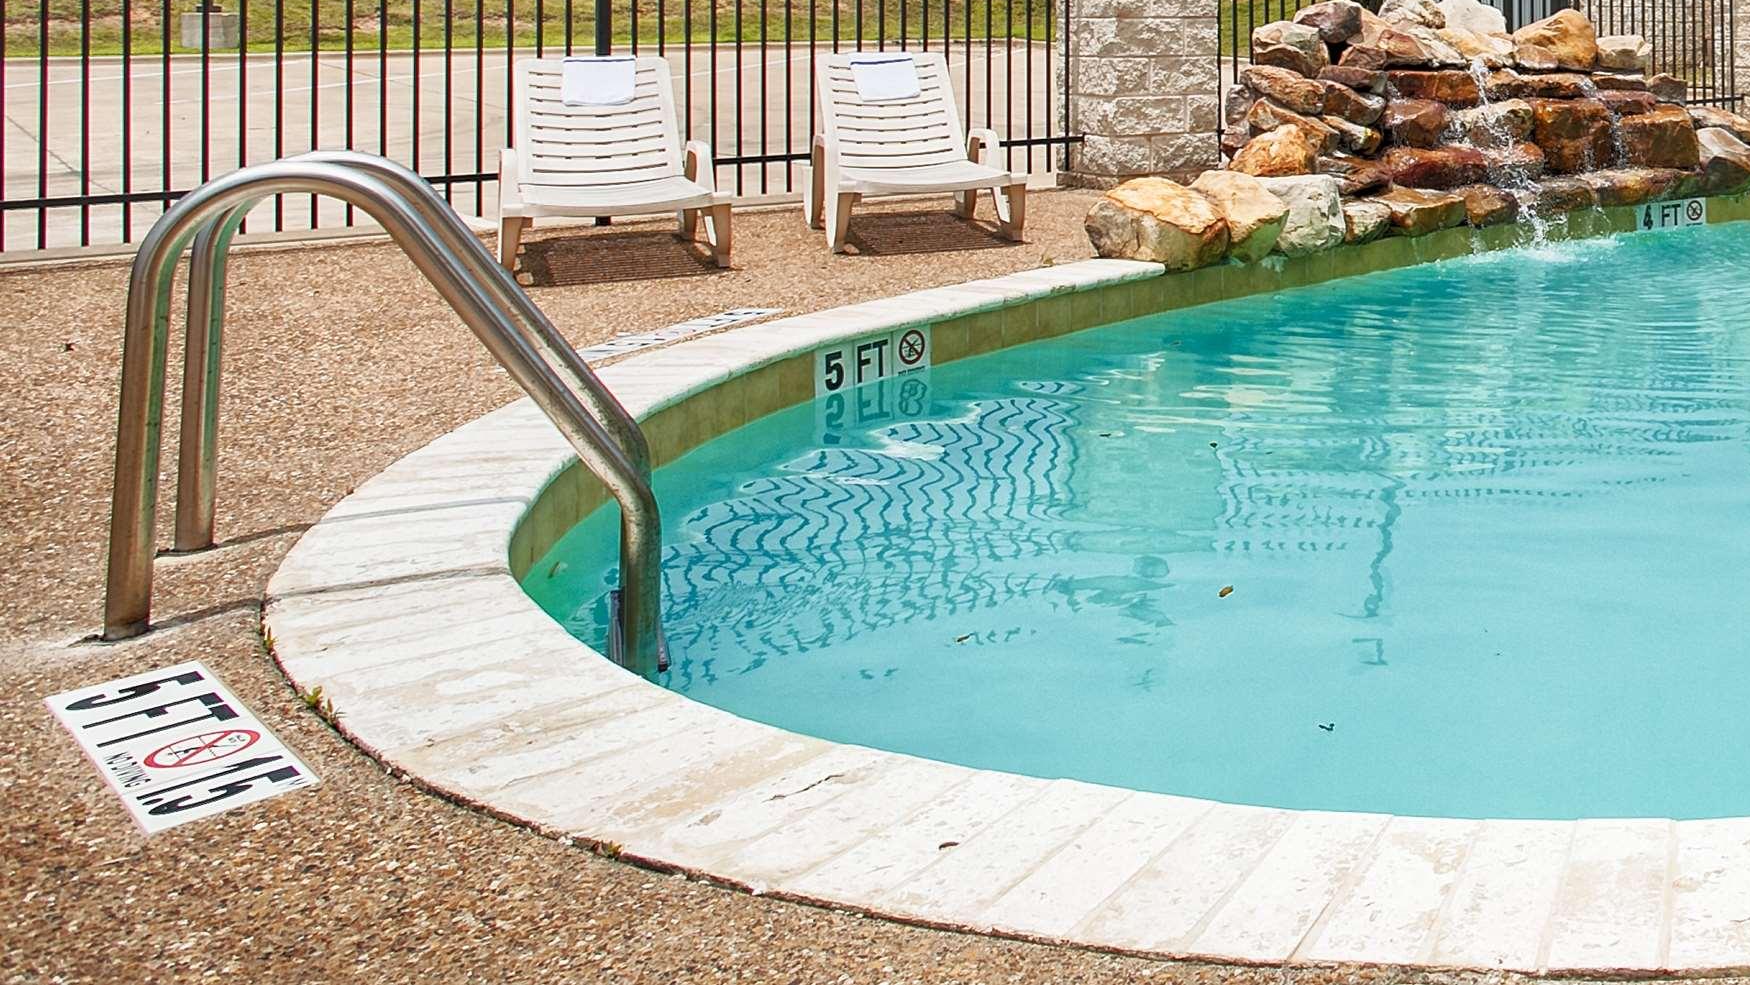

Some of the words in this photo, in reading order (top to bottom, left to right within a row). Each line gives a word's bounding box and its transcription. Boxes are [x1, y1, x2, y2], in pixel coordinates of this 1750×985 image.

[1643, 205, 1653, 230] 4
[1661, 203, 1681, 227] FT
[825, 351, 844, 391] 5
[857, 339, 889, 383] FT
[65, 671, 205, 711] 5
[82, 692, 240, 748] FT
[136, 755, 301, 815] 1.5
